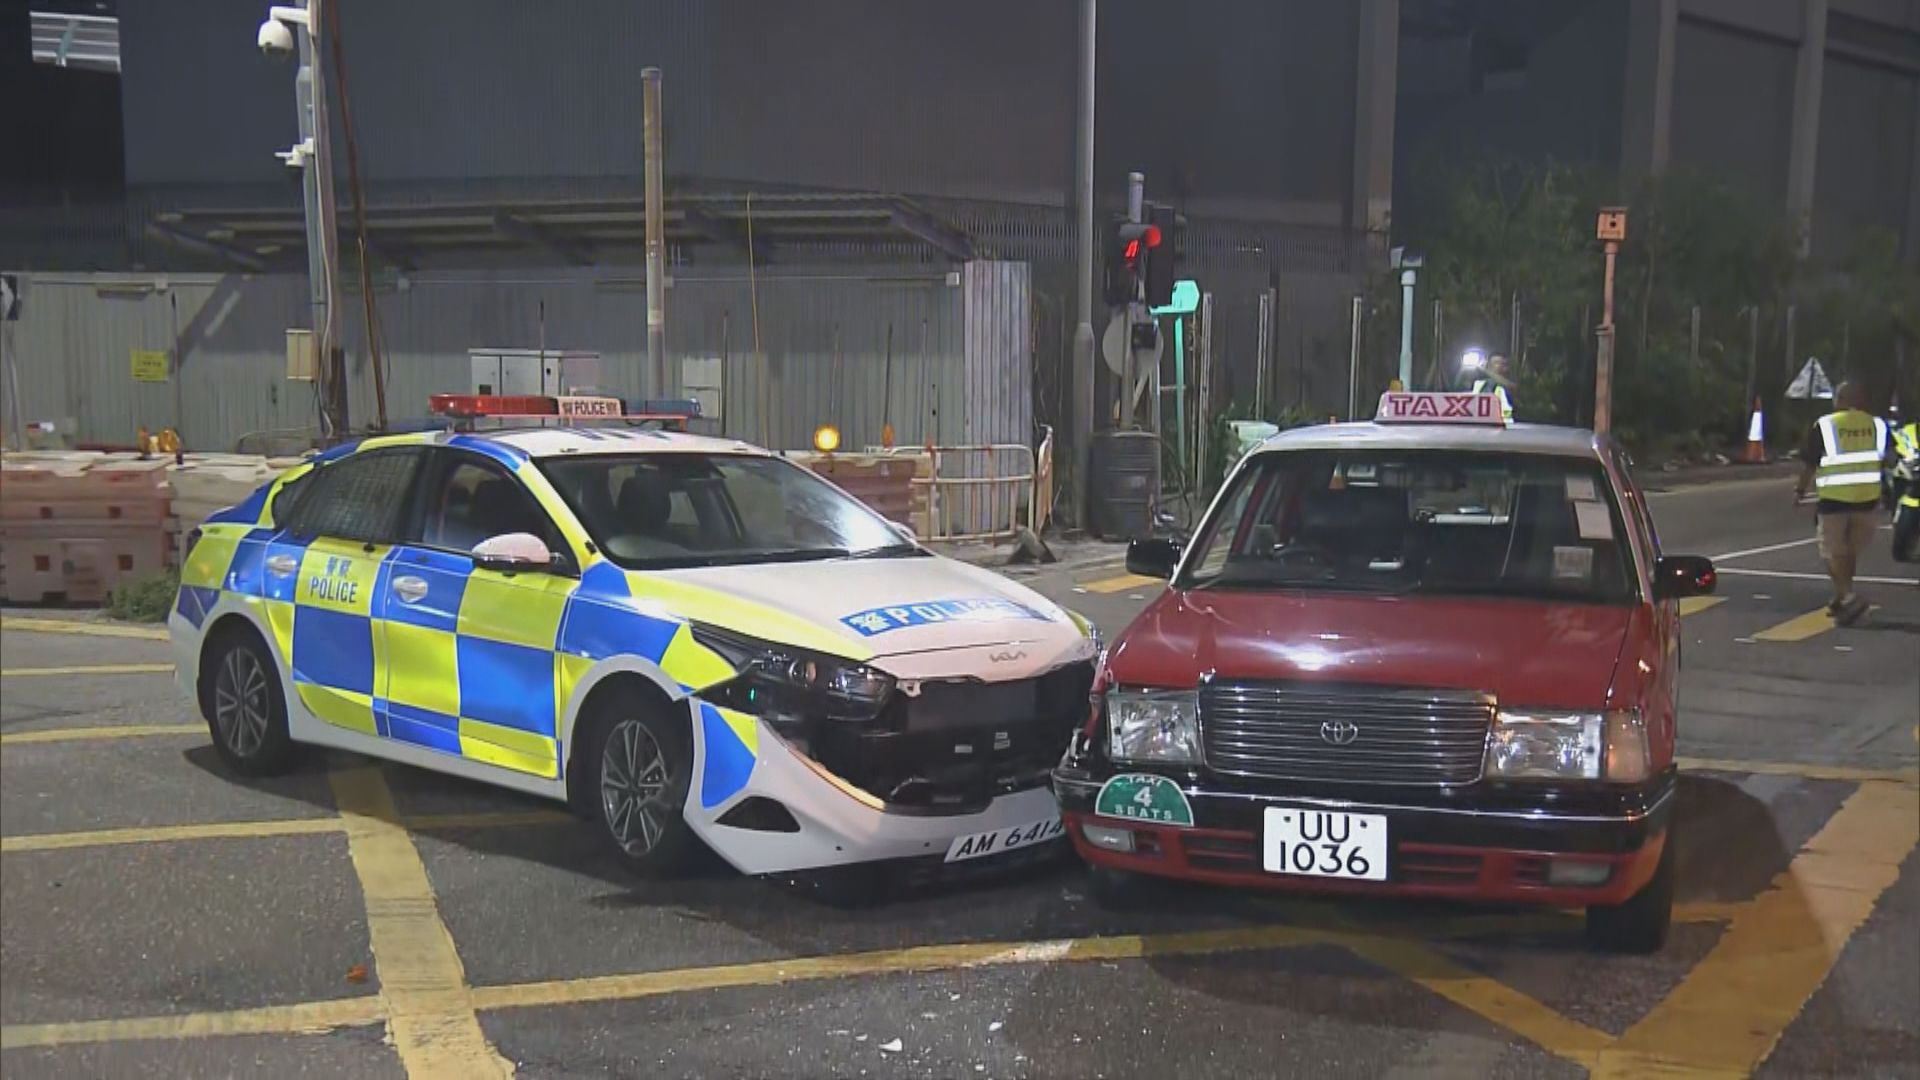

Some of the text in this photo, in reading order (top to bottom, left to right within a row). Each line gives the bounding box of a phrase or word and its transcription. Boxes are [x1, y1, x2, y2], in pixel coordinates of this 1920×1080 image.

[575, 400, 606, 415] POLICE
[1388, 395, 1491, 417] TAXI
[310, 576, 359, 603] POLICE
[885, 600, 1016, 625] POLI
[1133, 786, 1152, 807] 4
[1115, 804, 1172, 820] SEATS
[1300, 811, 1350, 843] UU
[955, 832, 998, 857] AM
[1280, 840, 1370, 875] 1036
